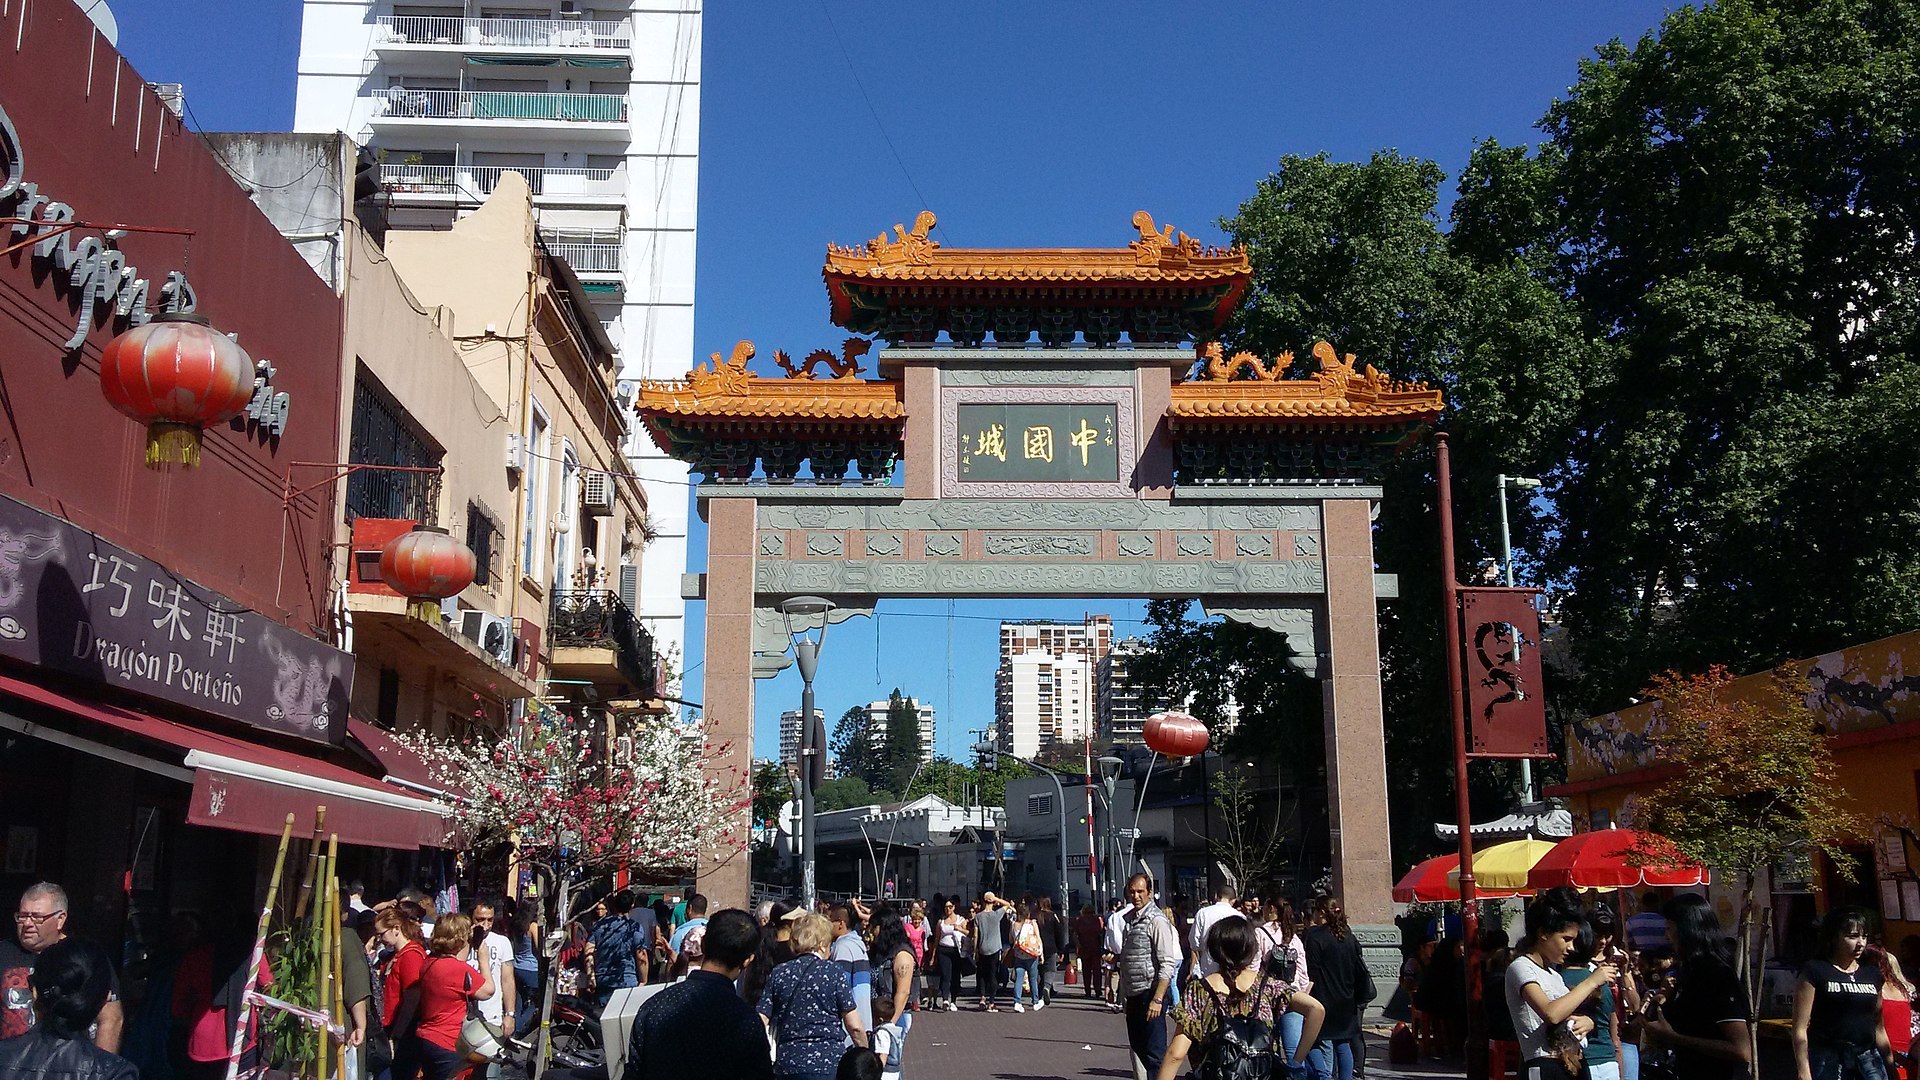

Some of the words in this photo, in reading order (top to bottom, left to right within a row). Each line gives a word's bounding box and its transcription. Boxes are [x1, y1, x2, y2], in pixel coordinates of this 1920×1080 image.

[973, 418, 1098, 467] 中國城
[82, 553, 246, 664] 巧味軒
[73, 620, 161, 681] Dragón
[165, 652, 243, 706] Porteño
[1827, 981, 1841, 993] NO
